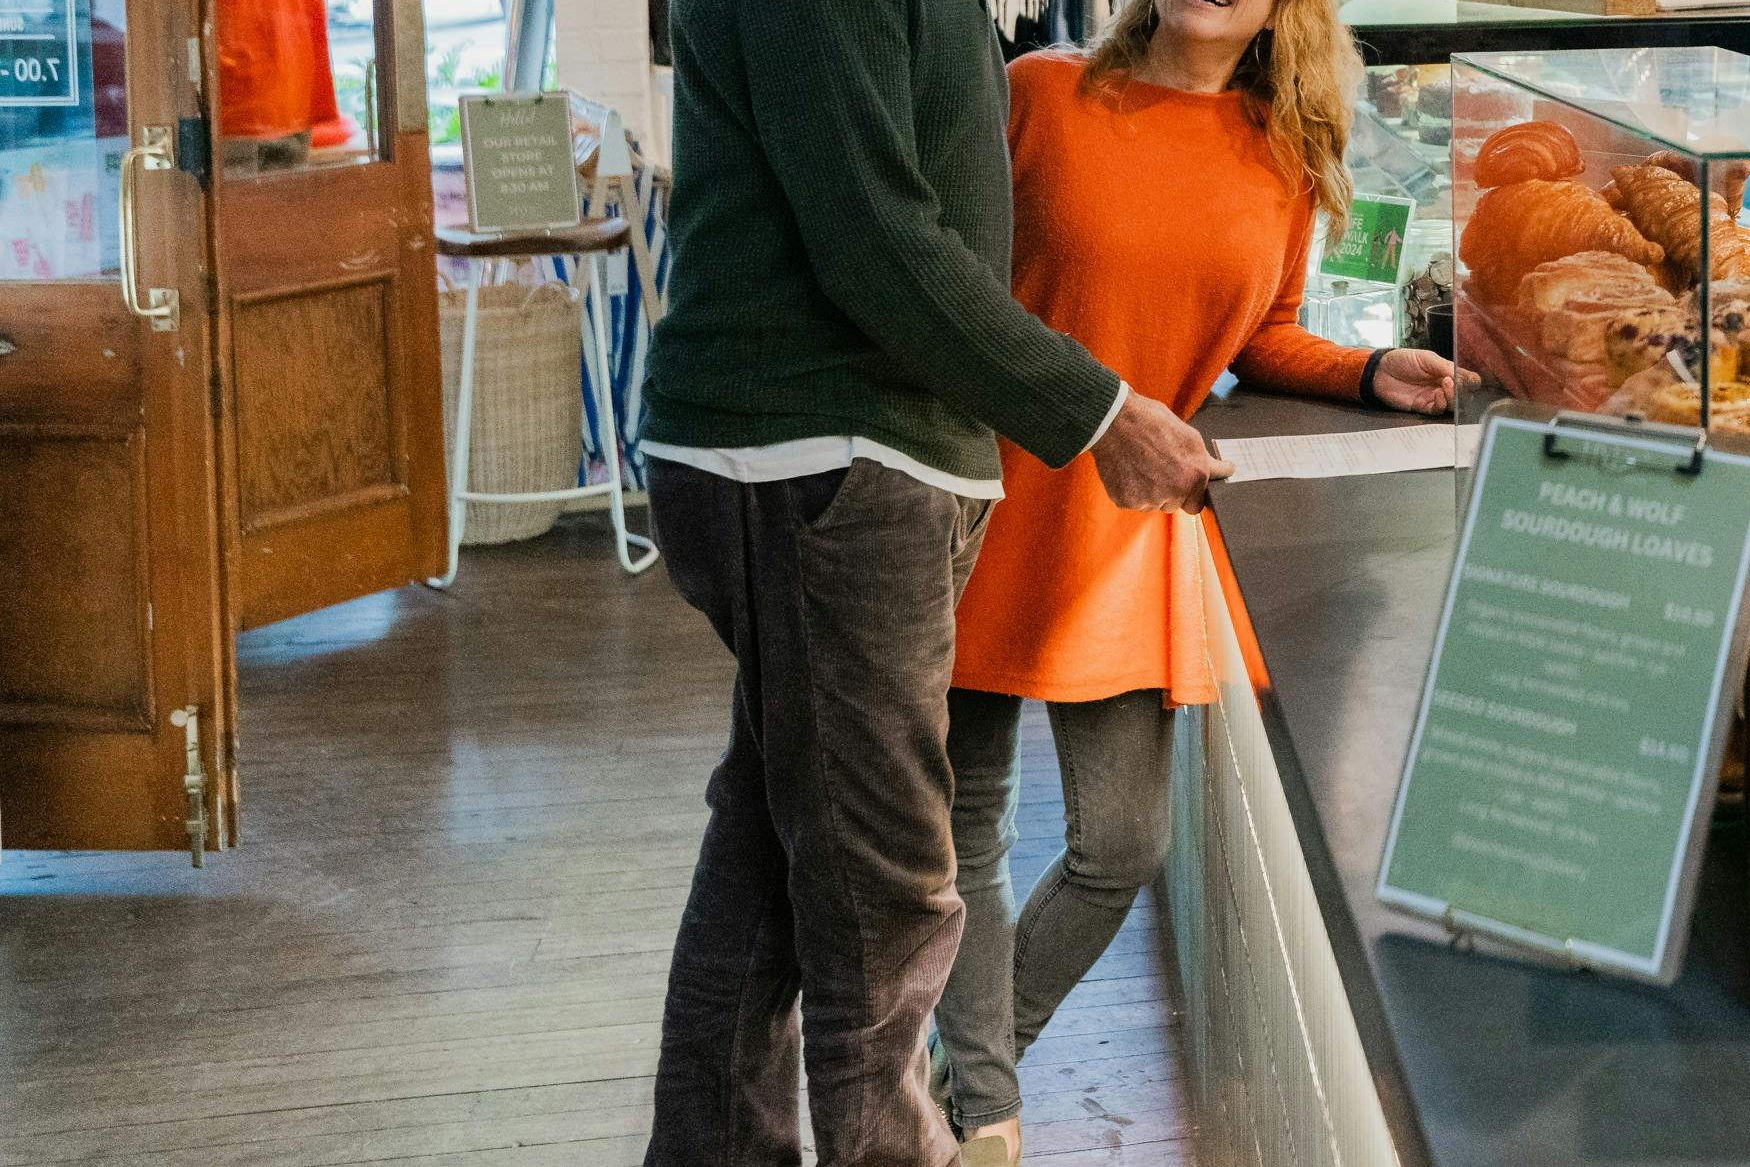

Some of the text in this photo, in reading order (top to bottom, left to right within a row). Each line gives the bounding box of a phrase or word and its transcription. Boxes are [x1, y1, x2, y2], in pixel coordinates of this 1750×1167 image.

[483, 135, 558, 148] OUR RETAIL
[501, 150, 542, 163] STORE
[491, 163, 554, 179] OPENS AT
[529, 180, 549, 192] AM
[1339, 242, 1363, 256] 2024
[1538, 481, 1686, 526] PEACH & WOLF
[1500, 509, 1714, 568] SOURDOUGH LOAVES
